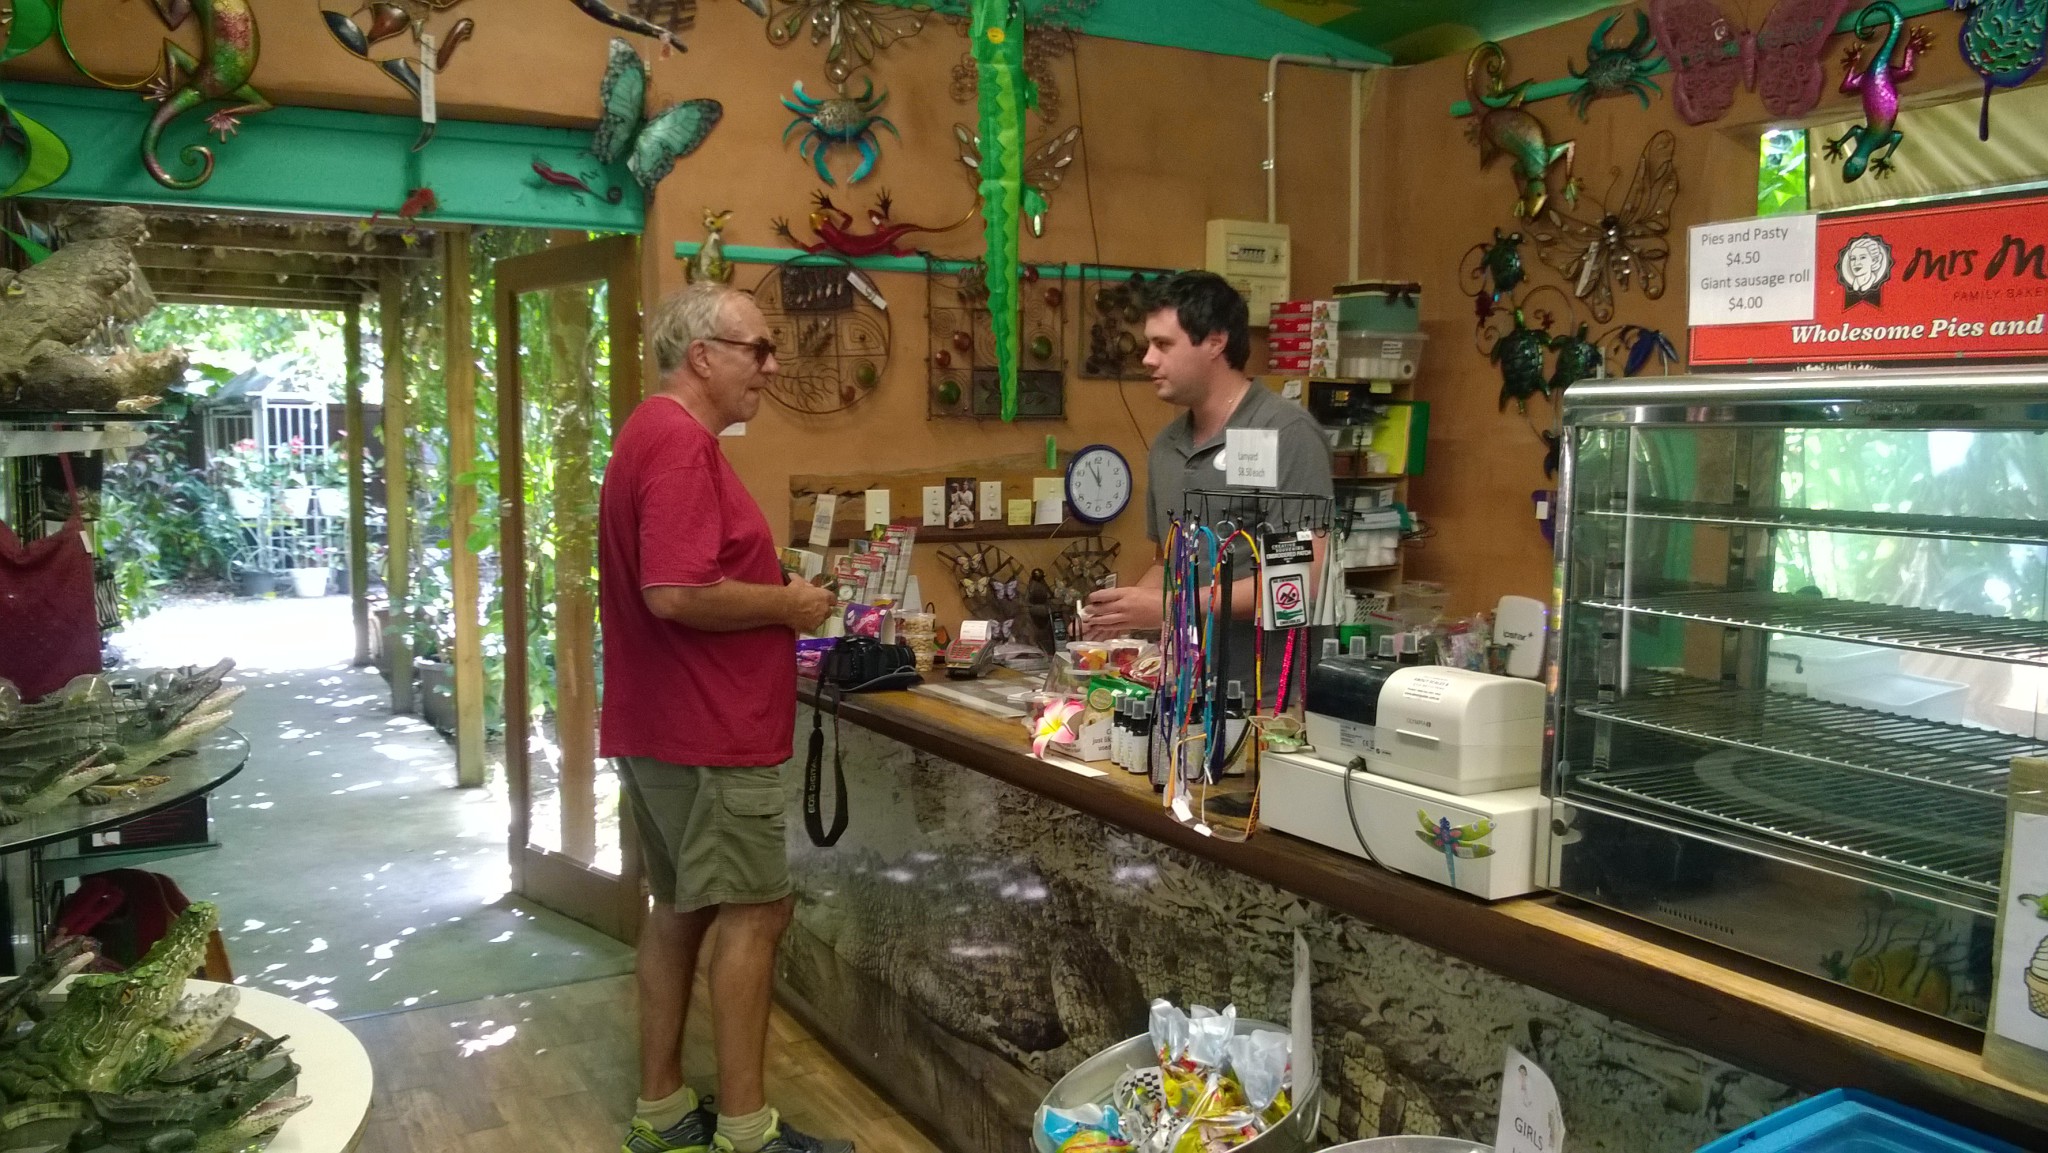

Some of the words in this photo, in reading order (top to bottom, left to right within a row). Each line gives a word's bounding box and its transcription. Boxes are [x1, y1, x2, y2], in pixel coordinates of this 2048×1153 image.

[1701, 232, 1725, 246] Pies
[1727, 228, 1750, 243] and
[1753, 225, 1789, 243] Pasty
[1726, 251, 1760, 268] $4.50
[1902, 246, 1978, 283] Mrs
[1701, 276, 1731, 291] Giant
[1734, 273, 1785, 289] sausage
[1789, 269, 1811, 284] roll
[1728, 295, 1763, 312] $4.00
[1953, 289, 2000, 301] FAMILY
[2006, 286, 2048, 299] BAKE
[1791, 321, 1924, 344] Wholesome
[1928, 317, 1985, 339] Pies
[1989, 313, 2045, 336] and
[1514, 1117, 1543, 1151] GIRLS
